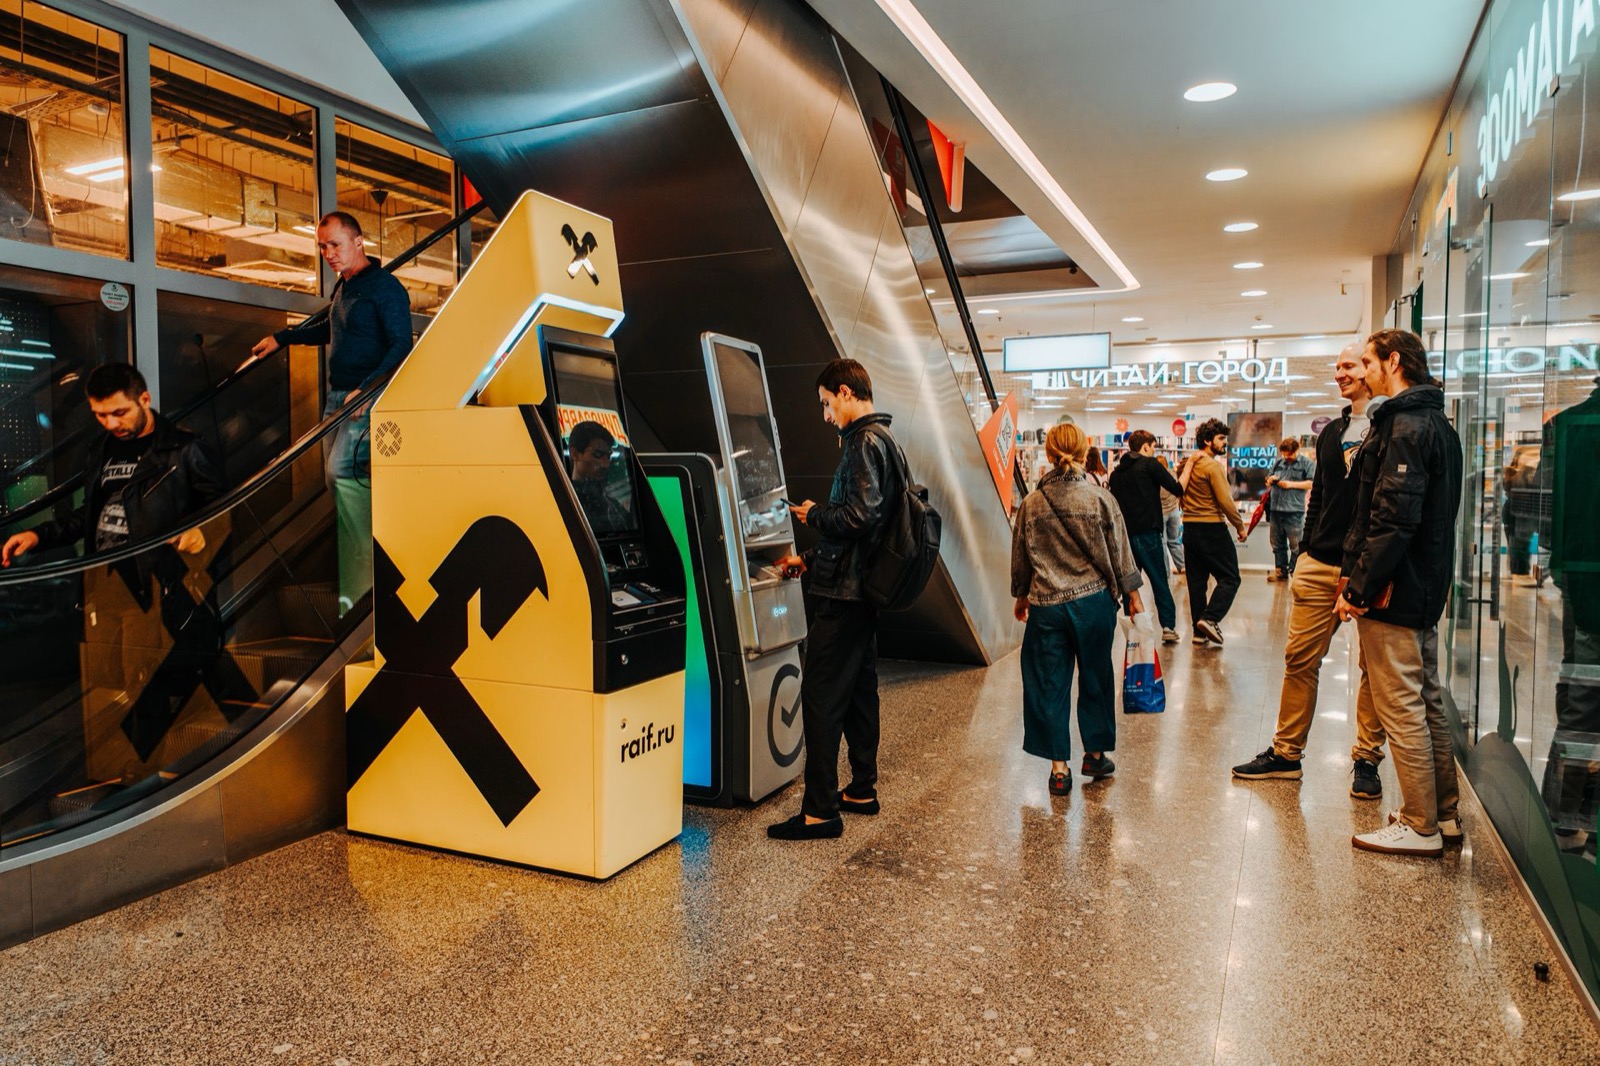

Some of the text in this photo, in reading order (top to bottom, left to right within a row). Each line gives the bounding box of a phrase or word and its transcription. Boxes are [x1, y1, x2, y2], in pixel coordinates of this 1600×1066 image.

[1477, 0, 1600, 199] ЗООМАГА
[1183, 358, 1290, 385] ГОРОД
[1231, 444, 1277, 457] ЧИТАЙ
[1231, 458, 1276, 469] ГОРОД
[621, 722, 675, 763] raif.ru
